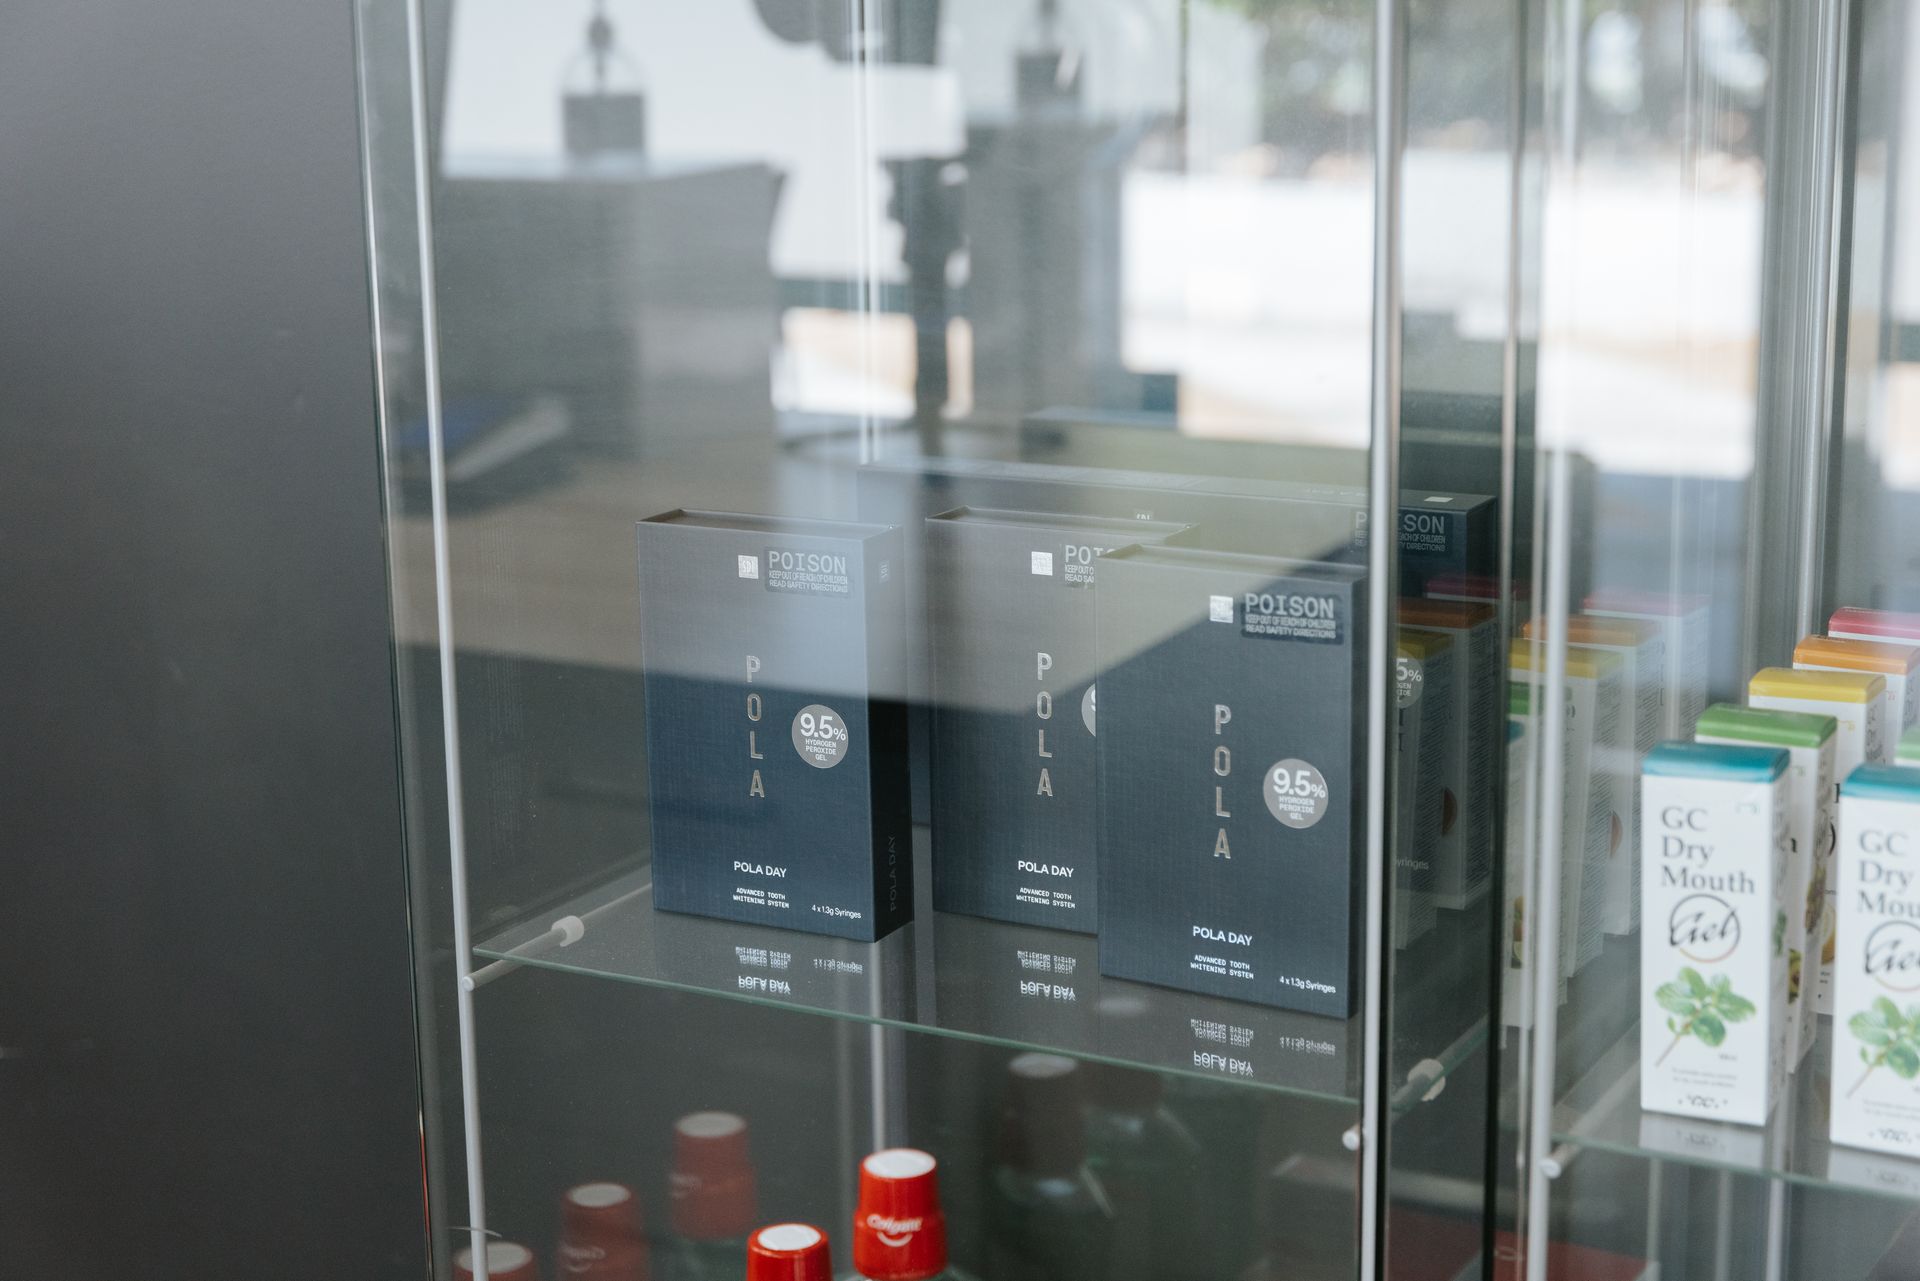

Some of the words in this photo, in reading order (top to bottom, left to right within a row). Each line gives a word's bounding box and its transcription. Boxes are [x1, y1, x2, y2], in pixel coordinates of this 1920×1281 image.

[768, 550, 846, 575] POISON
[1245, 593, 1334, 618] POISON
[746, 655, 765, 798] POLA
[800, 712, 846, 741] 9.5%
[1036, 652, 1053, 797] POLA
[805, 738, 837, 748] HYDROGEN
[805, 745, 837, 756] PEROXIDE
[815, 753, 828, 761] GEL
[1214, 704, 1231, 859] POLA
[1272, 767, 1326, 799] 9.5%
[1662, 806, 1708, 831] GC
[1662, 835, 1714, 868] Dry
[1859, 829, 1908, 857] GC
[733, 860, 763, 875] POLA
[766, 865, 787, 878] DAY
[1017, 860, 1049, 875] POLA
[1051, 865, 1074, 878] DAY
[1661, 863, 1756, 895] Mouth
[1858, 859, 1913, 894] Dry
[732, 894, 765, 905] WHITENING
[767, 900, 789, 909] SYSTEM
[736, 887, 765, 898] ADVANCED
[768, 891, 786, 900] TOOTH
[1016, 894, 1050, 905] WHITENING
[1052, 900, 1076, 909] SYSTEM
[1020, 887, 1050, 898] ADVANCED
[1053, 892, 1072, 901] TOOTH
[834, 907, 862, 919] Syringes
[1857, 889, 1920, 919] Mou
[1193, 926, 1226, 941] POLA
[1228, 932, 1252, 946] DAY
[1190, 962, 1226, 975] WHITENING
[1229, 969, 1254, 979] SYSTEM
[1194, 954, 1226, 966] ADVANCED
[1230, 960, 1250, 970] TOOTH
[1306, 980, 1336, 993] Syringes
